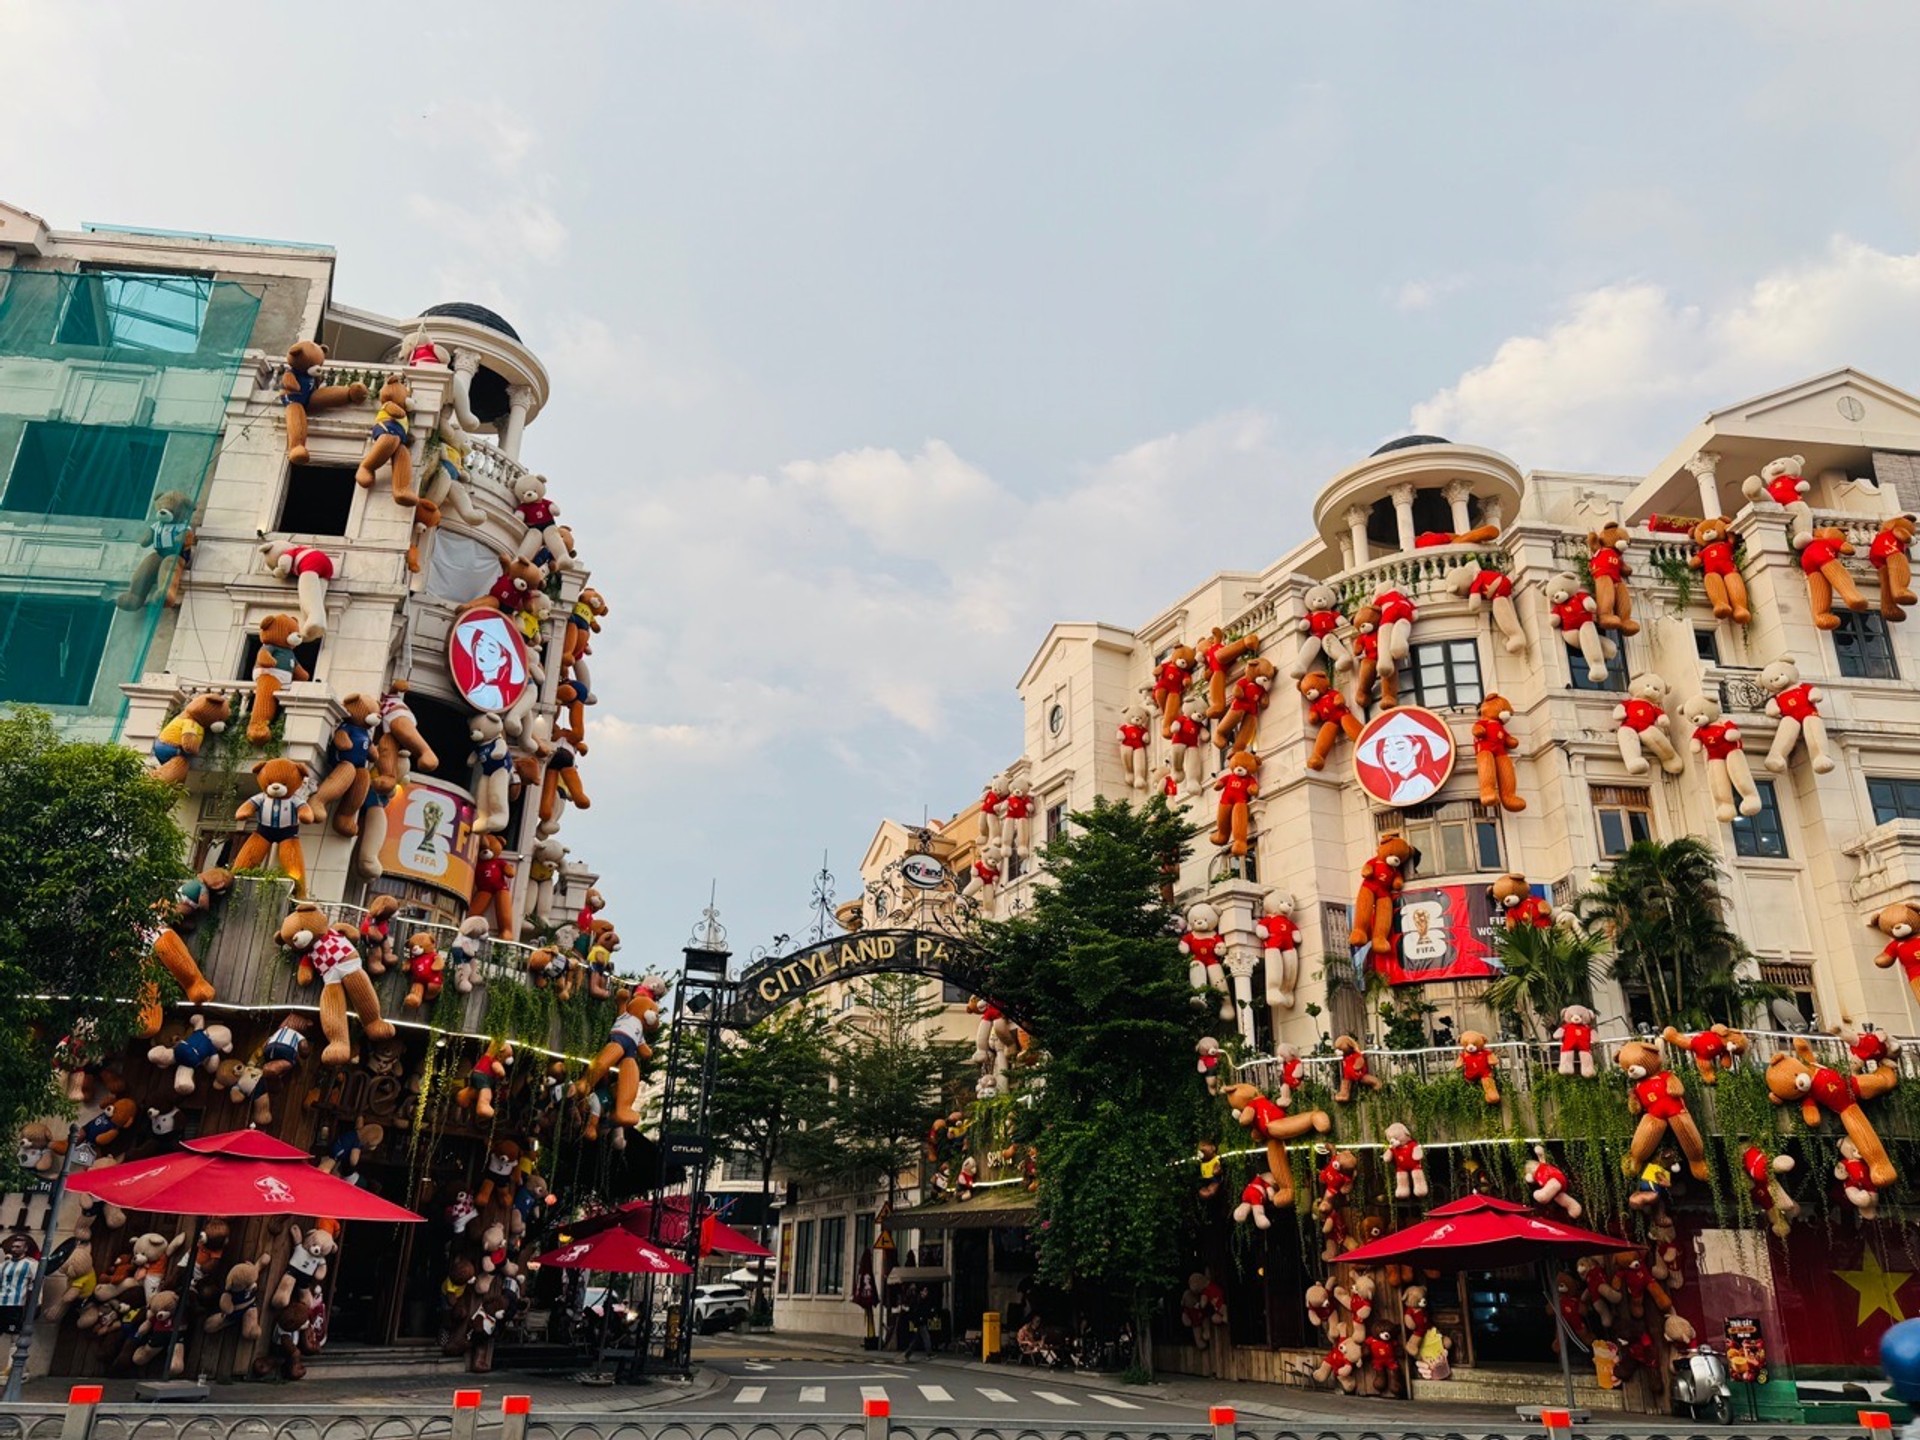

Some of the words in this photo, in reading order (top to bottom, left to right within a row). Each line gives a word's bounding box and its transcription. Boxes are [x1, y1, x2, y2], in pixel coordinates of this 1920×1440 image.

[1608, 556, 1618, 565] 10
[1707, 736, 1715, 744] 2
[414, 854, 437, 868] FIFA
[1379, 873, 1387, 881] 2
[1489, 916, 1508, 925] FIF
[1416, 946, 1435, 954] FIFA
[759, 937, 895, 1002] CITYLAND
[916, 937, 949, 962] PA
[672, 1145, 703, 1154] CITYLAND
